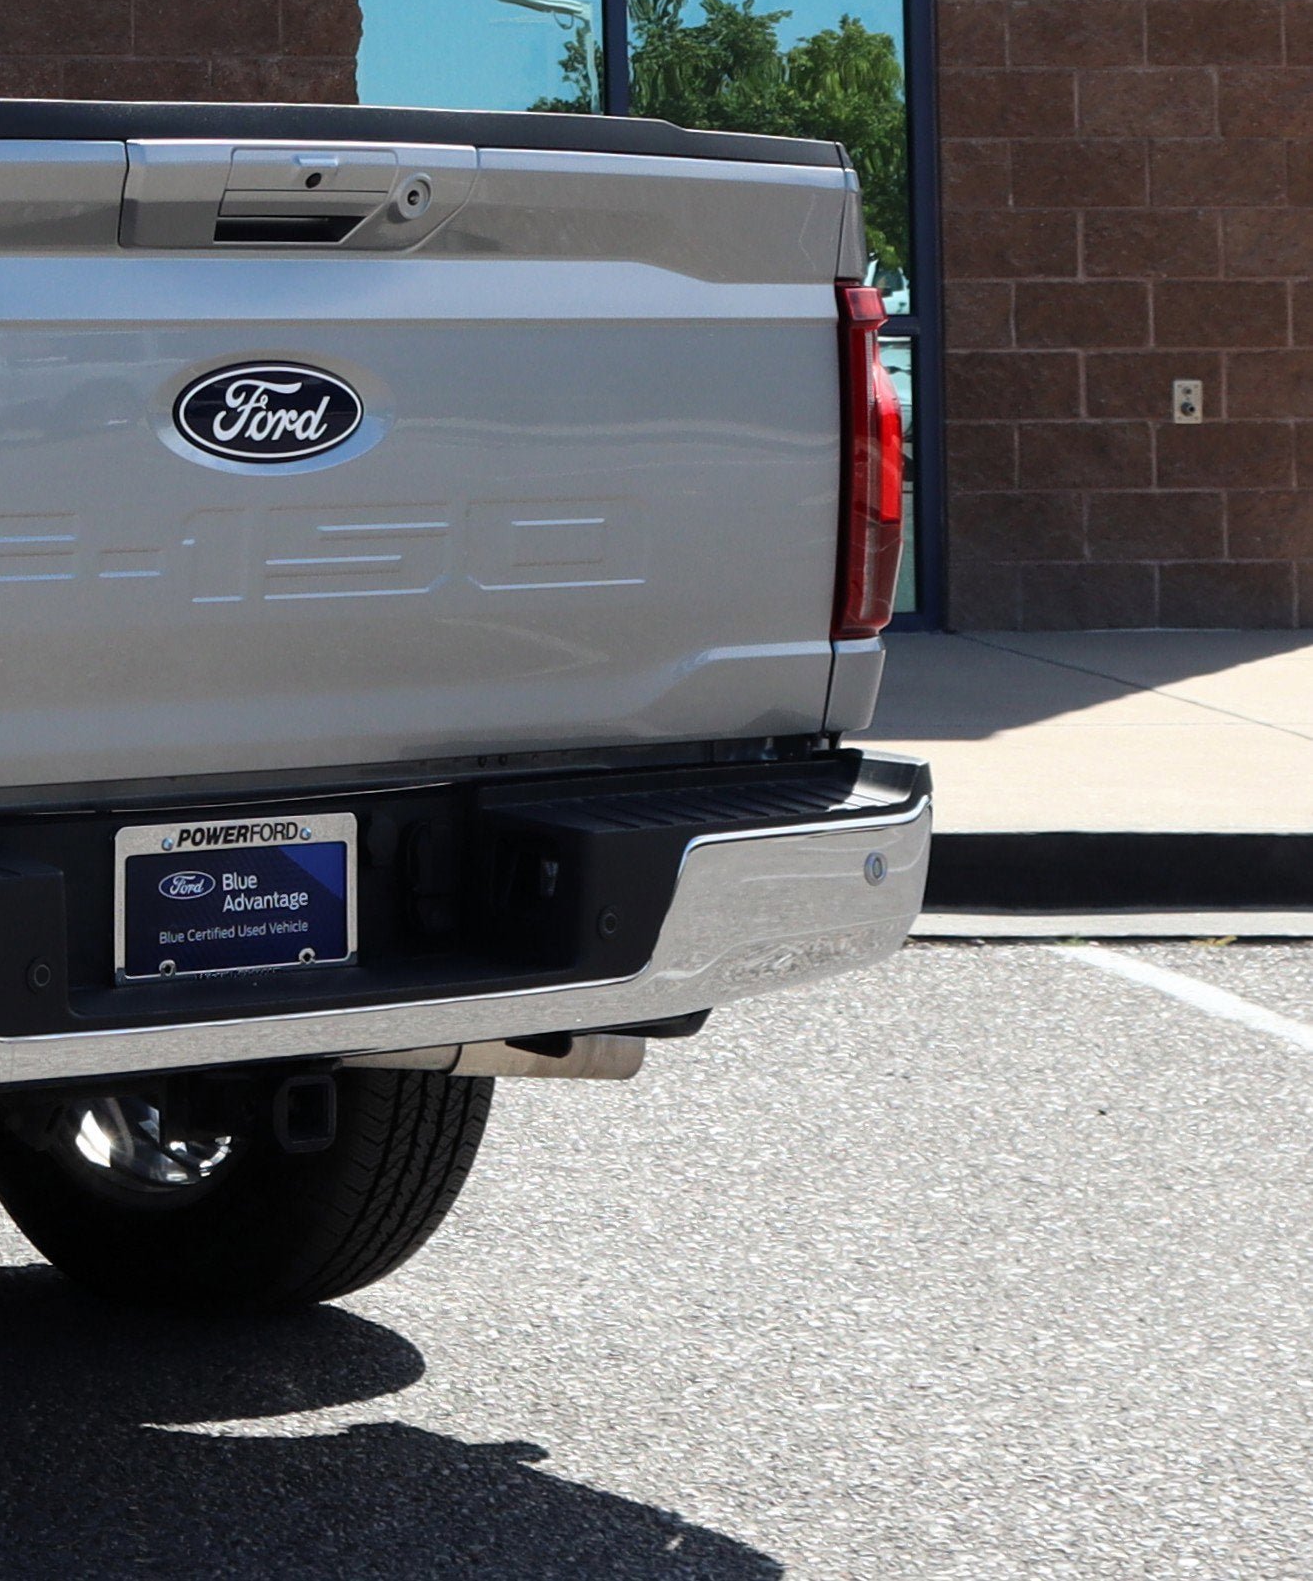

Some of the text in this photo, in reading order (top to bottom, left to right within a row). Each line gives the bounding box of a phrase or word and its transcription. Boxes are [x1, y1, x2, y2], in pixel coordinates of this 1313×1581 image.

[213, 378, 331, 443] Ford
[176, 821, 299, 848] POWERFORD
[169, 875, 205, 896] Ford
[222, 872, 258, 892] Blue
[222, 890, 309, 913] Advantage
[159, 919, 309, 945] Blue Certified Used Vehicle
